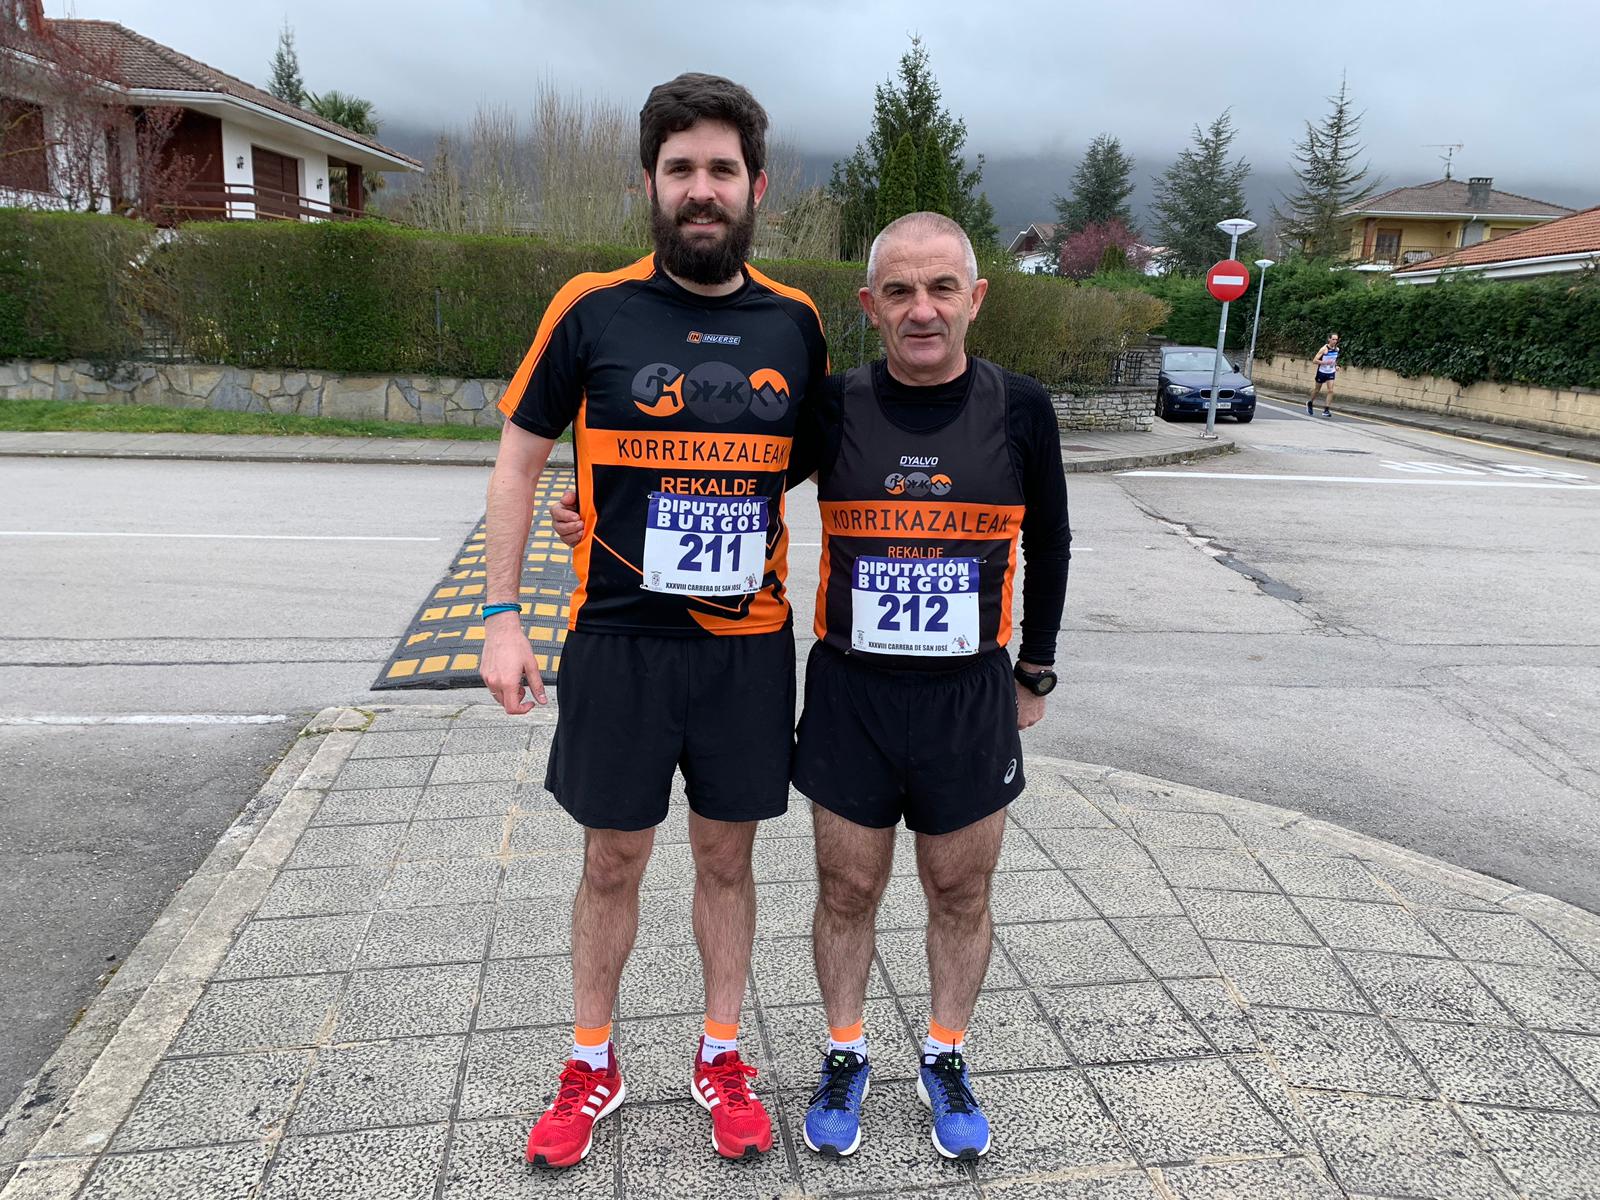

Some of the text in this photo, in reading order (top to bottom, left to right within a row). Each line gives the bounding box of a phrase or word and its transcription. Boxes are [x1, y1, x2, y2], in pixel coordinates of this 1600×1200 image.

[704, 334, 740, 344] INVERSE
[617, 438, 787, 464] KORRIKAZALEAK
[900, 456, 939, 467] DYALVO
[661, 477, 757, 495] REKALDE
[658, 498, 761, 516] DIPUTACIÓN
[657, 512, 760, 532] BURGOS
[831, 508, 1012, 534] KORRIKAZALEAK
[677, 533, 742, 572] 211
[888, 546, 944, 558] REKALDE
[858, 560, 969, 576] DIPUTACIÓN
[665, 582, 687, 591] XXXVIII
[687, 583, 713, 592] CARRERA
[714, 584, 721, 592] DE
[858, 574, 970, 592] BURGOS
[877, 594, 949, 632] 212
[868, 641, 887, 649] XXXVIII
[888, 643, 914, 651] CARRERA
